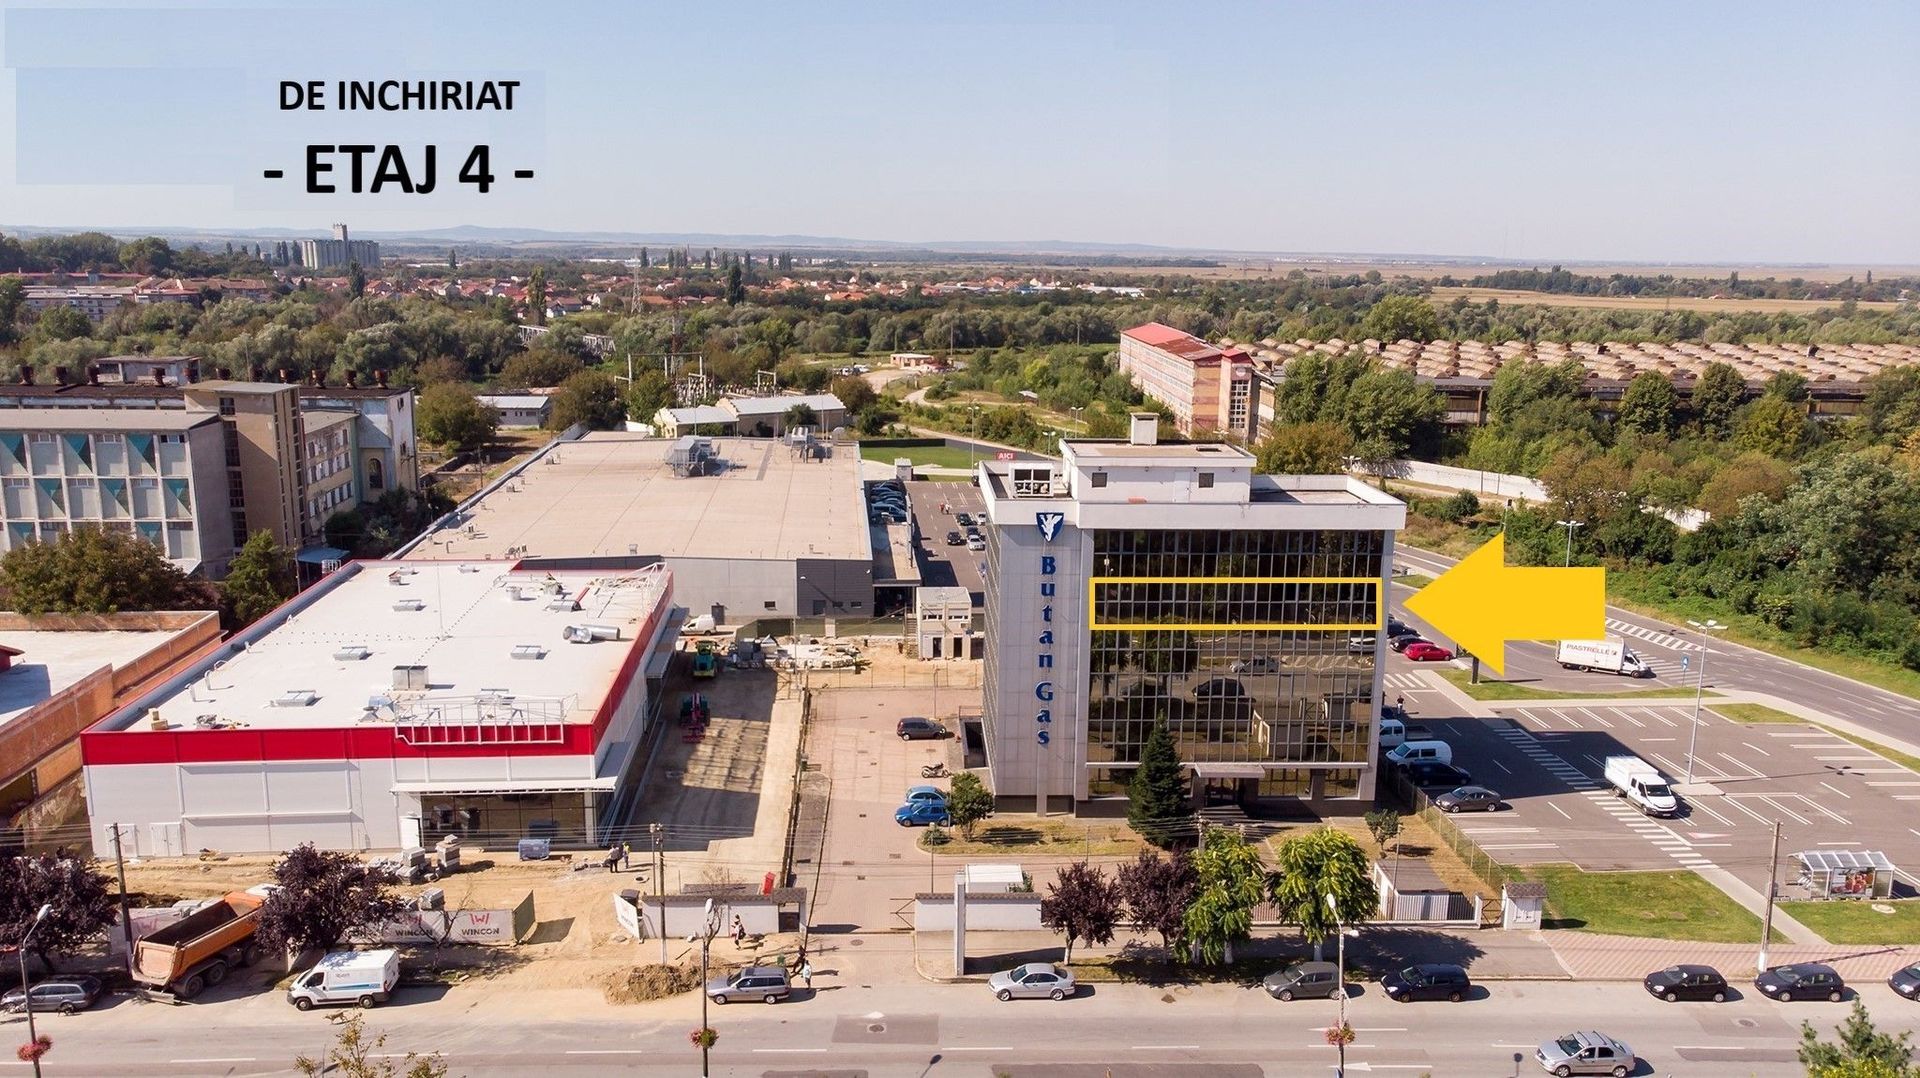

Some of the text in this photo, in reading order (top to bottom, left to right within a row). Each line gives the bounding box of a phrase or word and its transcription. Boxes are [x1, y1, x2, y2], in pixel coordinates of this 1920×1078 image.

[1035, 556, 1056, 745] Butan Gas
[395, 929, 433, 937] WINCON
[461, 928, 500, 936] WINCON
